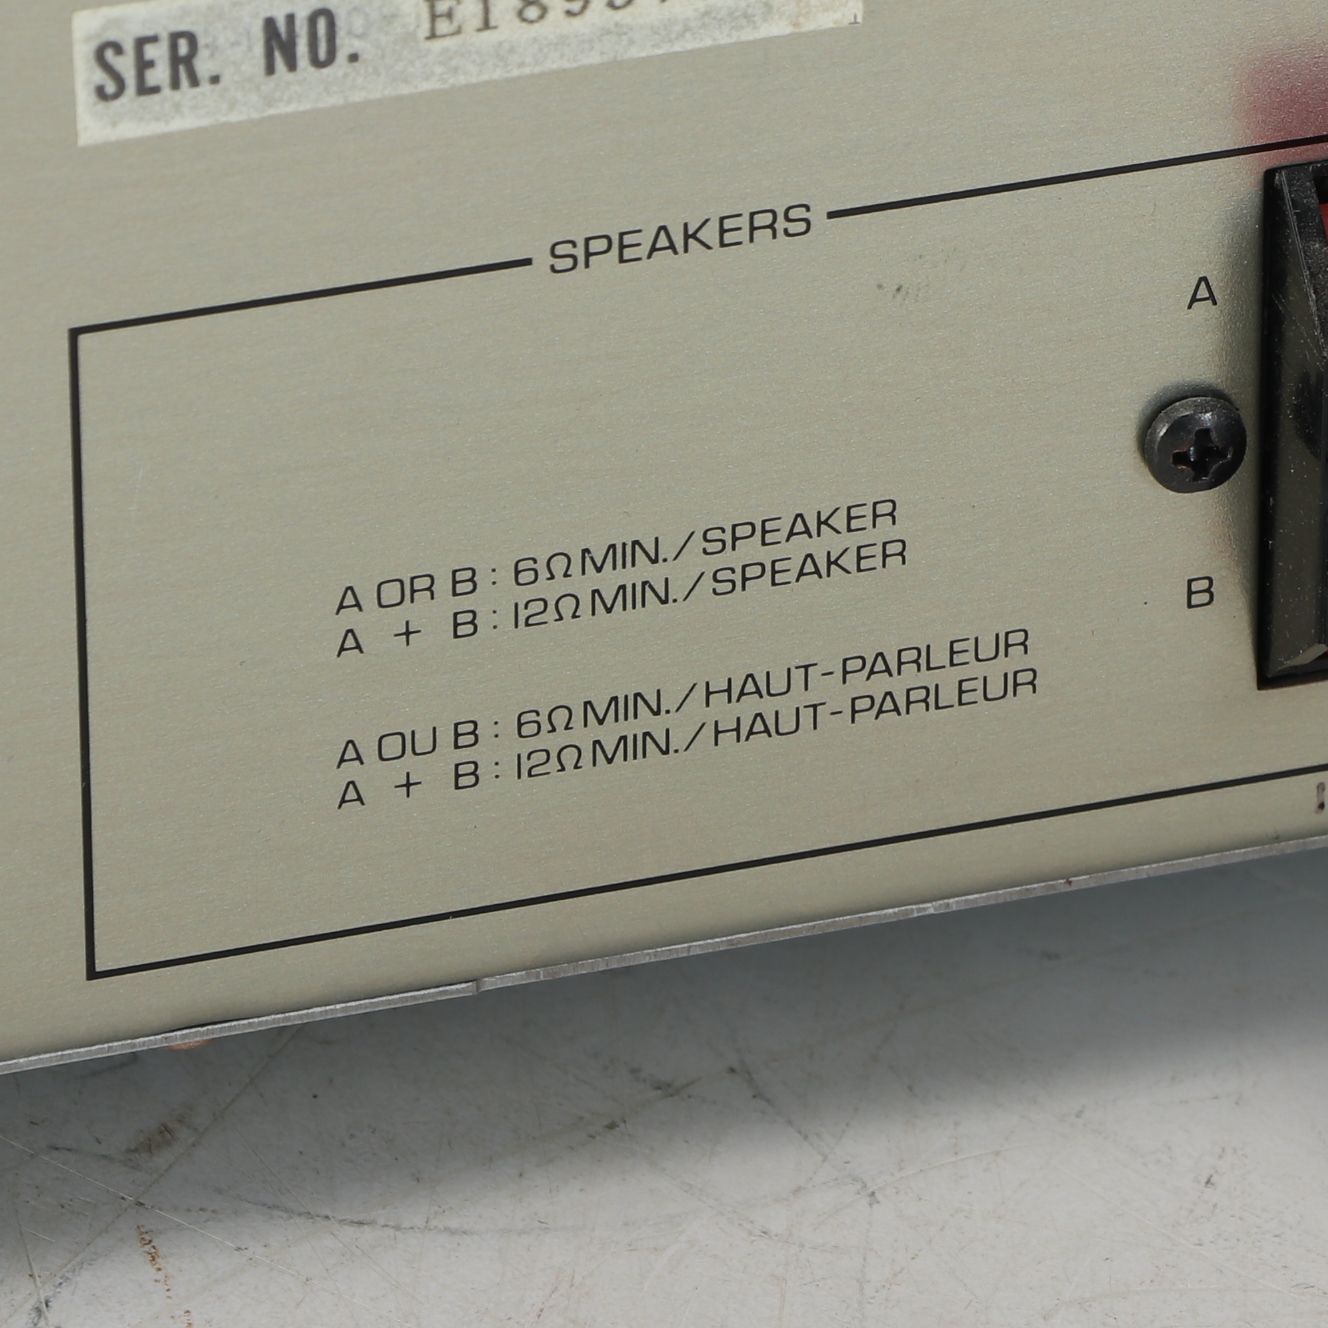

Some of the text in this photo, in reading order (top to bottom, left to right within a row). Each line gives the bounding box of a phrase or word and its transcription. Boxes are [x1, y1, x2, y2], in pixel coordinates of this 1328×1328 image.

[94, 30, 221, 103] SER.
[262, 7, 360, 76] NO.
[549, 203, 812, 274] SPEAKERS
[1186, 275, 1218, 310] A
[335, 585, 363, 616] A
[376, 563, 435, 608] OR
[1186, 575, 1215, 609] B
[336, 627, 364, 658] A
[336, 739, 365, 769] A
[377, 726, 437, 762] OU
[337, 780, 366, 810] A
